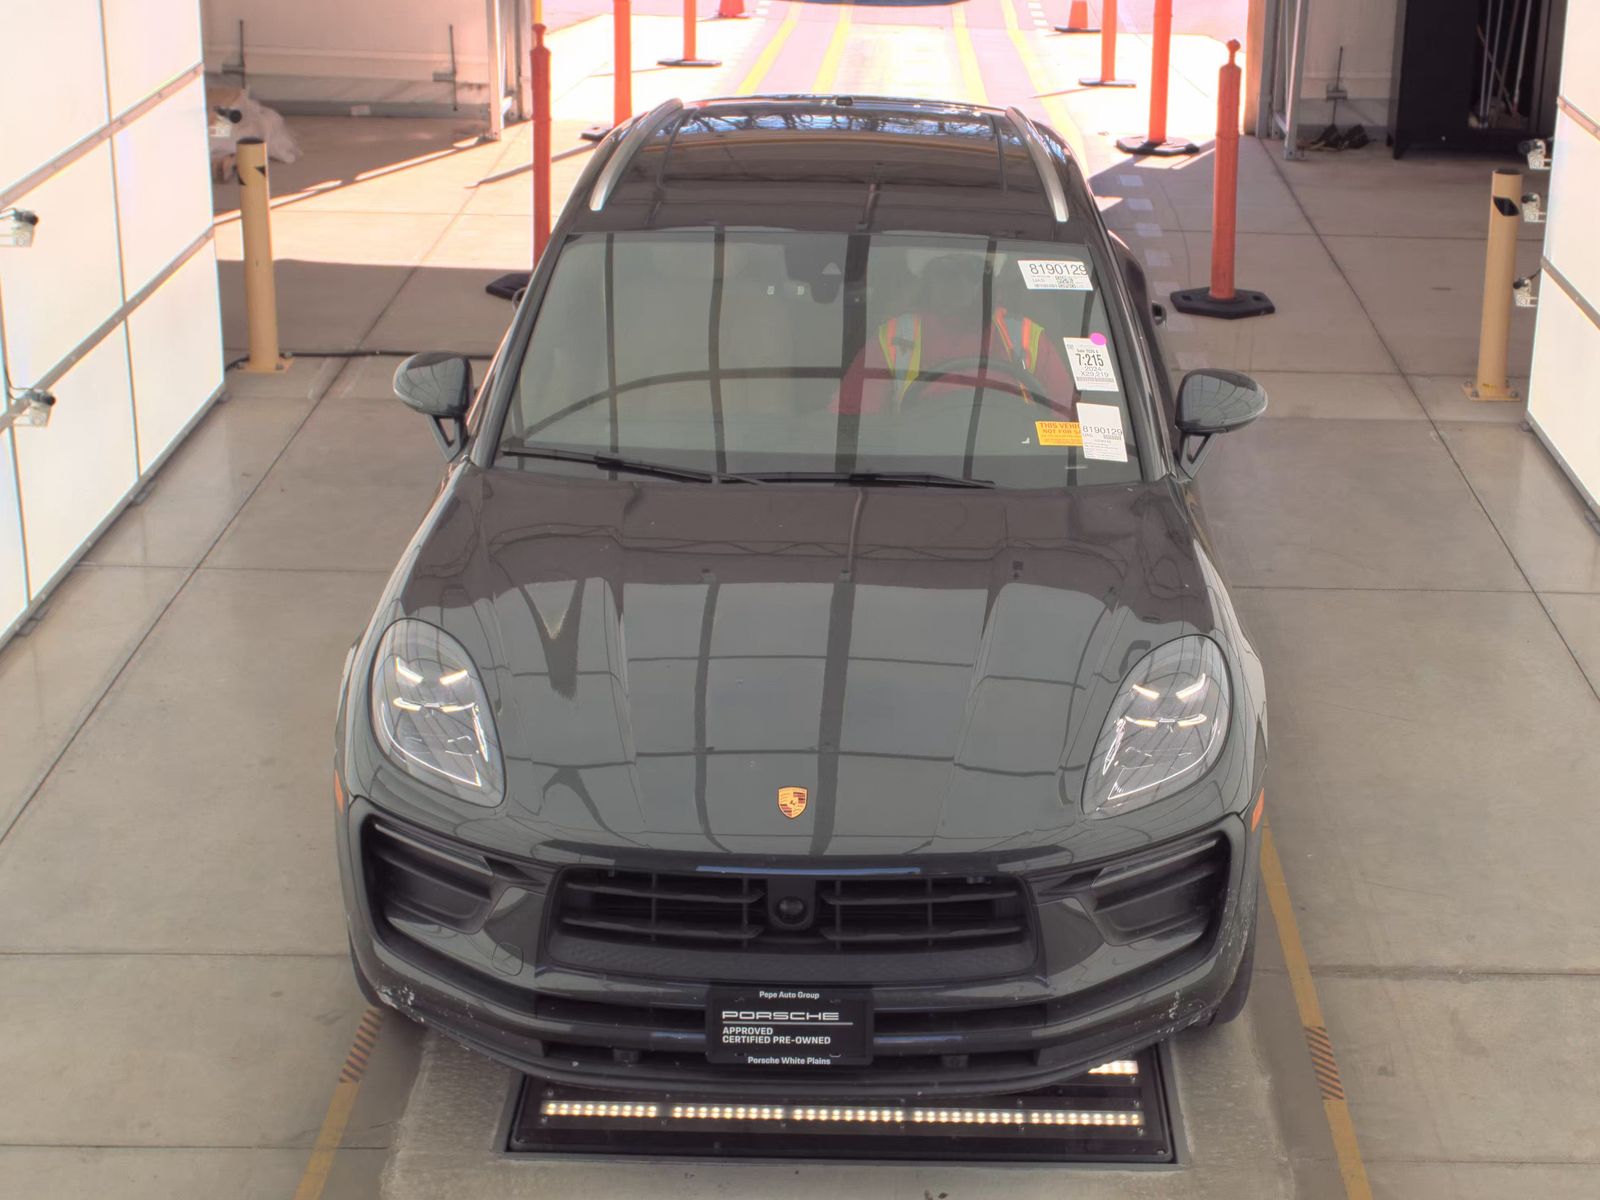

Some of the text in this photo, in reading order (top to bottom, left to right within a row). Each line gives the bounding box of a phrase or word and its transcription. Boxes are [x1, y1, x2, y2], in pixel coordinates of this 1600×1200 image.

[1029, 263, 1088, 275] 8190129
[1075, 353, 1104, 367] 7:215
[1082, 425, 1123, 435] 8190129
[759, 990, 820, 1000] Pepe Auto Group
[722, 1011, 840, 1021] PORSCHE
[722, 1026, 773, 1035] APPROVED
[722, 1035, 831, 1044] CERTIFIED PRE-OWNED
[748, 1056, 831, 1065] Porsche White Plains
